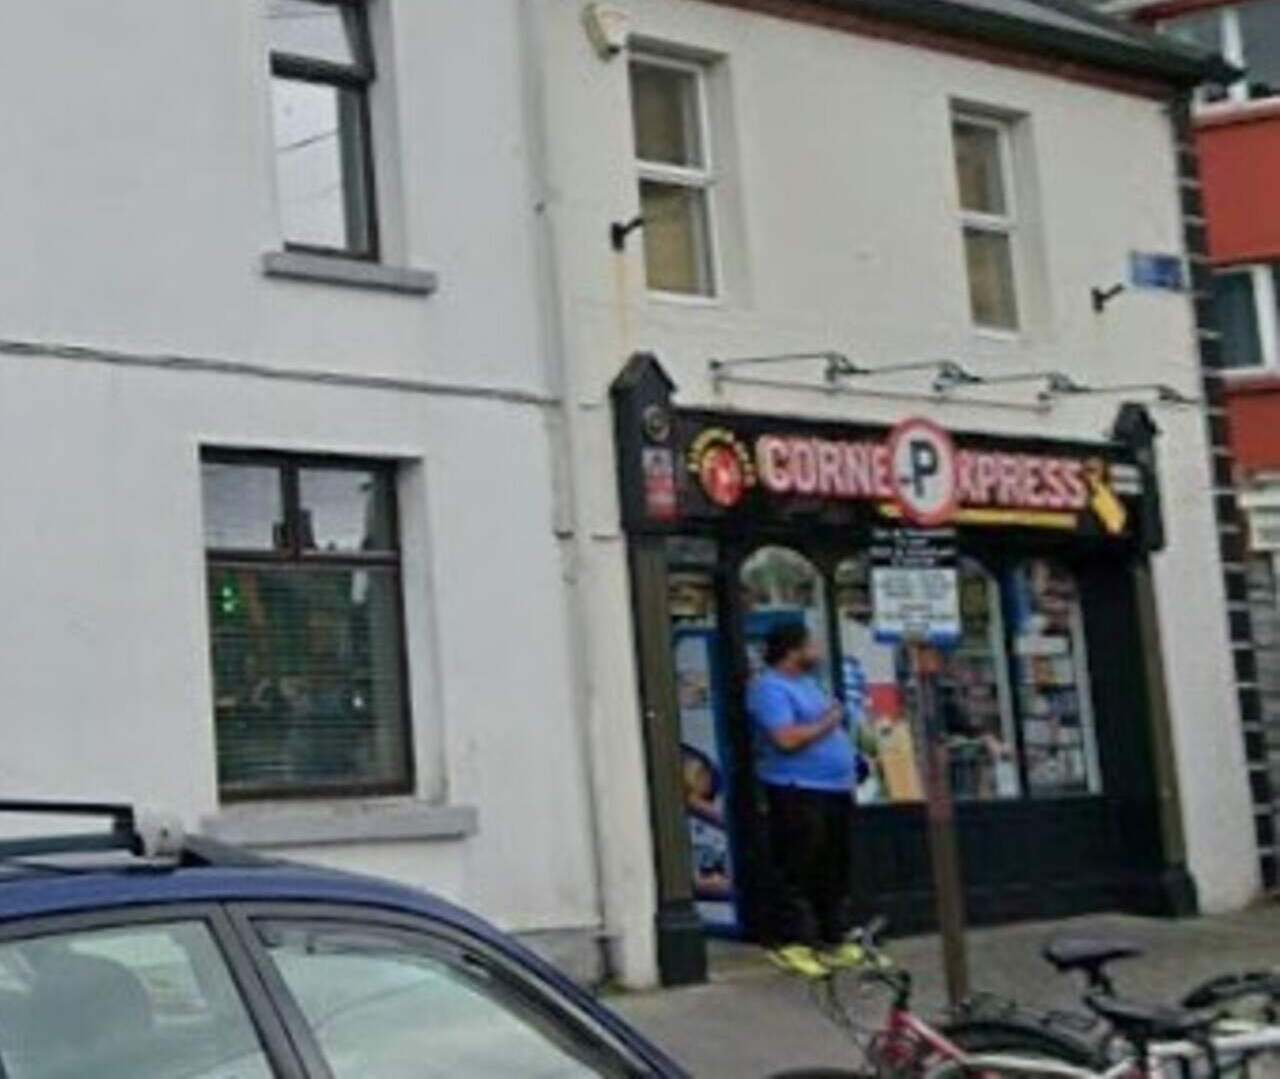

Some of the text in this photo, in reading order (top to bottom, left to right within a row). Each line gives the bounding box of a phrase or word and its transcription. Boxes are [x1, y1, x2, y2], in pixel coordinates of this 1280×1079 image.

[756, 435, 893, 498] CORNE
[952, 449, 1087, 508] XPRESS
[909, 440, 939, 499] P
